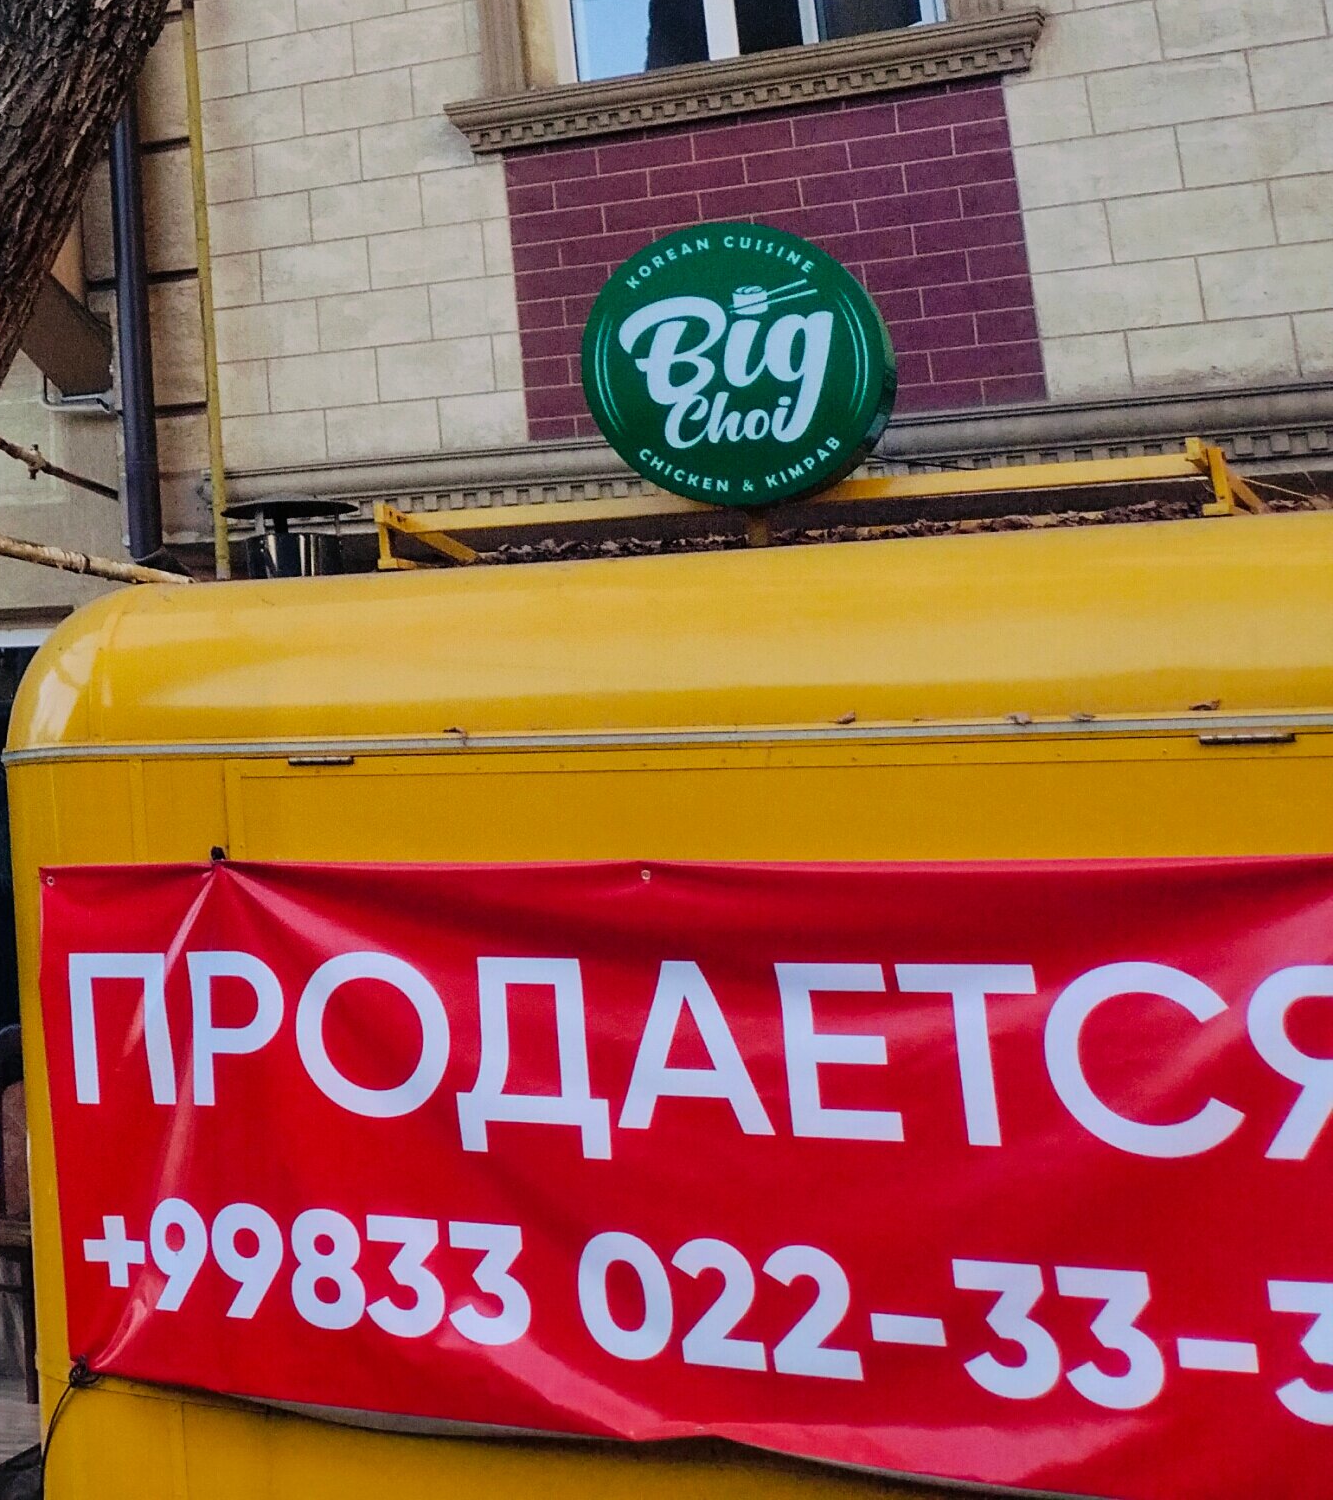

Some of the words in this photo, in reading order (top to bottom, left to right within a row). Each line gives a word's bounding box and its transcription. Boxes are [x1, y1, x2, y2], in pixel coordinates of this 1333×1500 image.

[625, 236, 710, 290] KOREAN
[723, 235, 817, 275] CUISINE
[618, 296, 834, 442] Big
[638, 448, 730, 493] CHICKEN
[742, 479, 755, 493] &
[764, 436, 842, 488] KIMPAB
[664, 392, 793, 450] Choi
[68, 950, 1333, 1160] ПРОДАЕТСЯ
[83, 1197, 531, 1346] +99833
